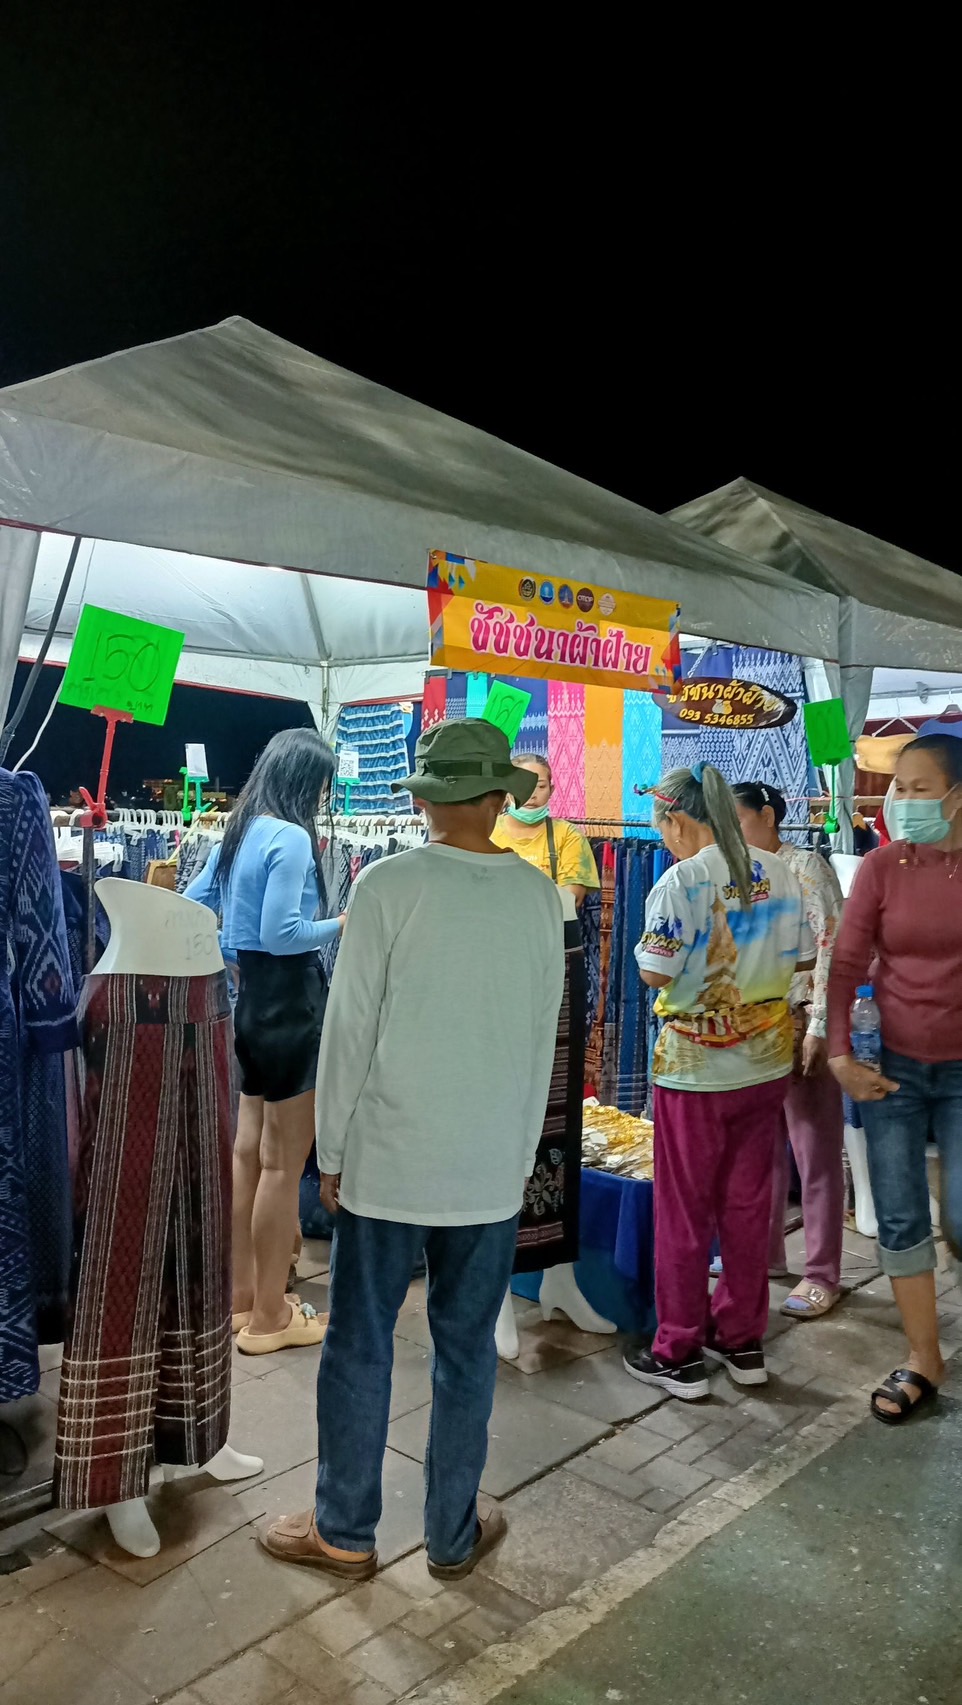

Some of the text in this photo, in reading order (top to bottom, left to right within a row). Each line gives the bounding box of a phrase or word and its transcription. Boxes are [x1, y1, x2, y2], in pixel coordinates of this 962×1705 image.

[82, 631, 161, 692] 150
[679, 708, 755, 726] 093 5346855
